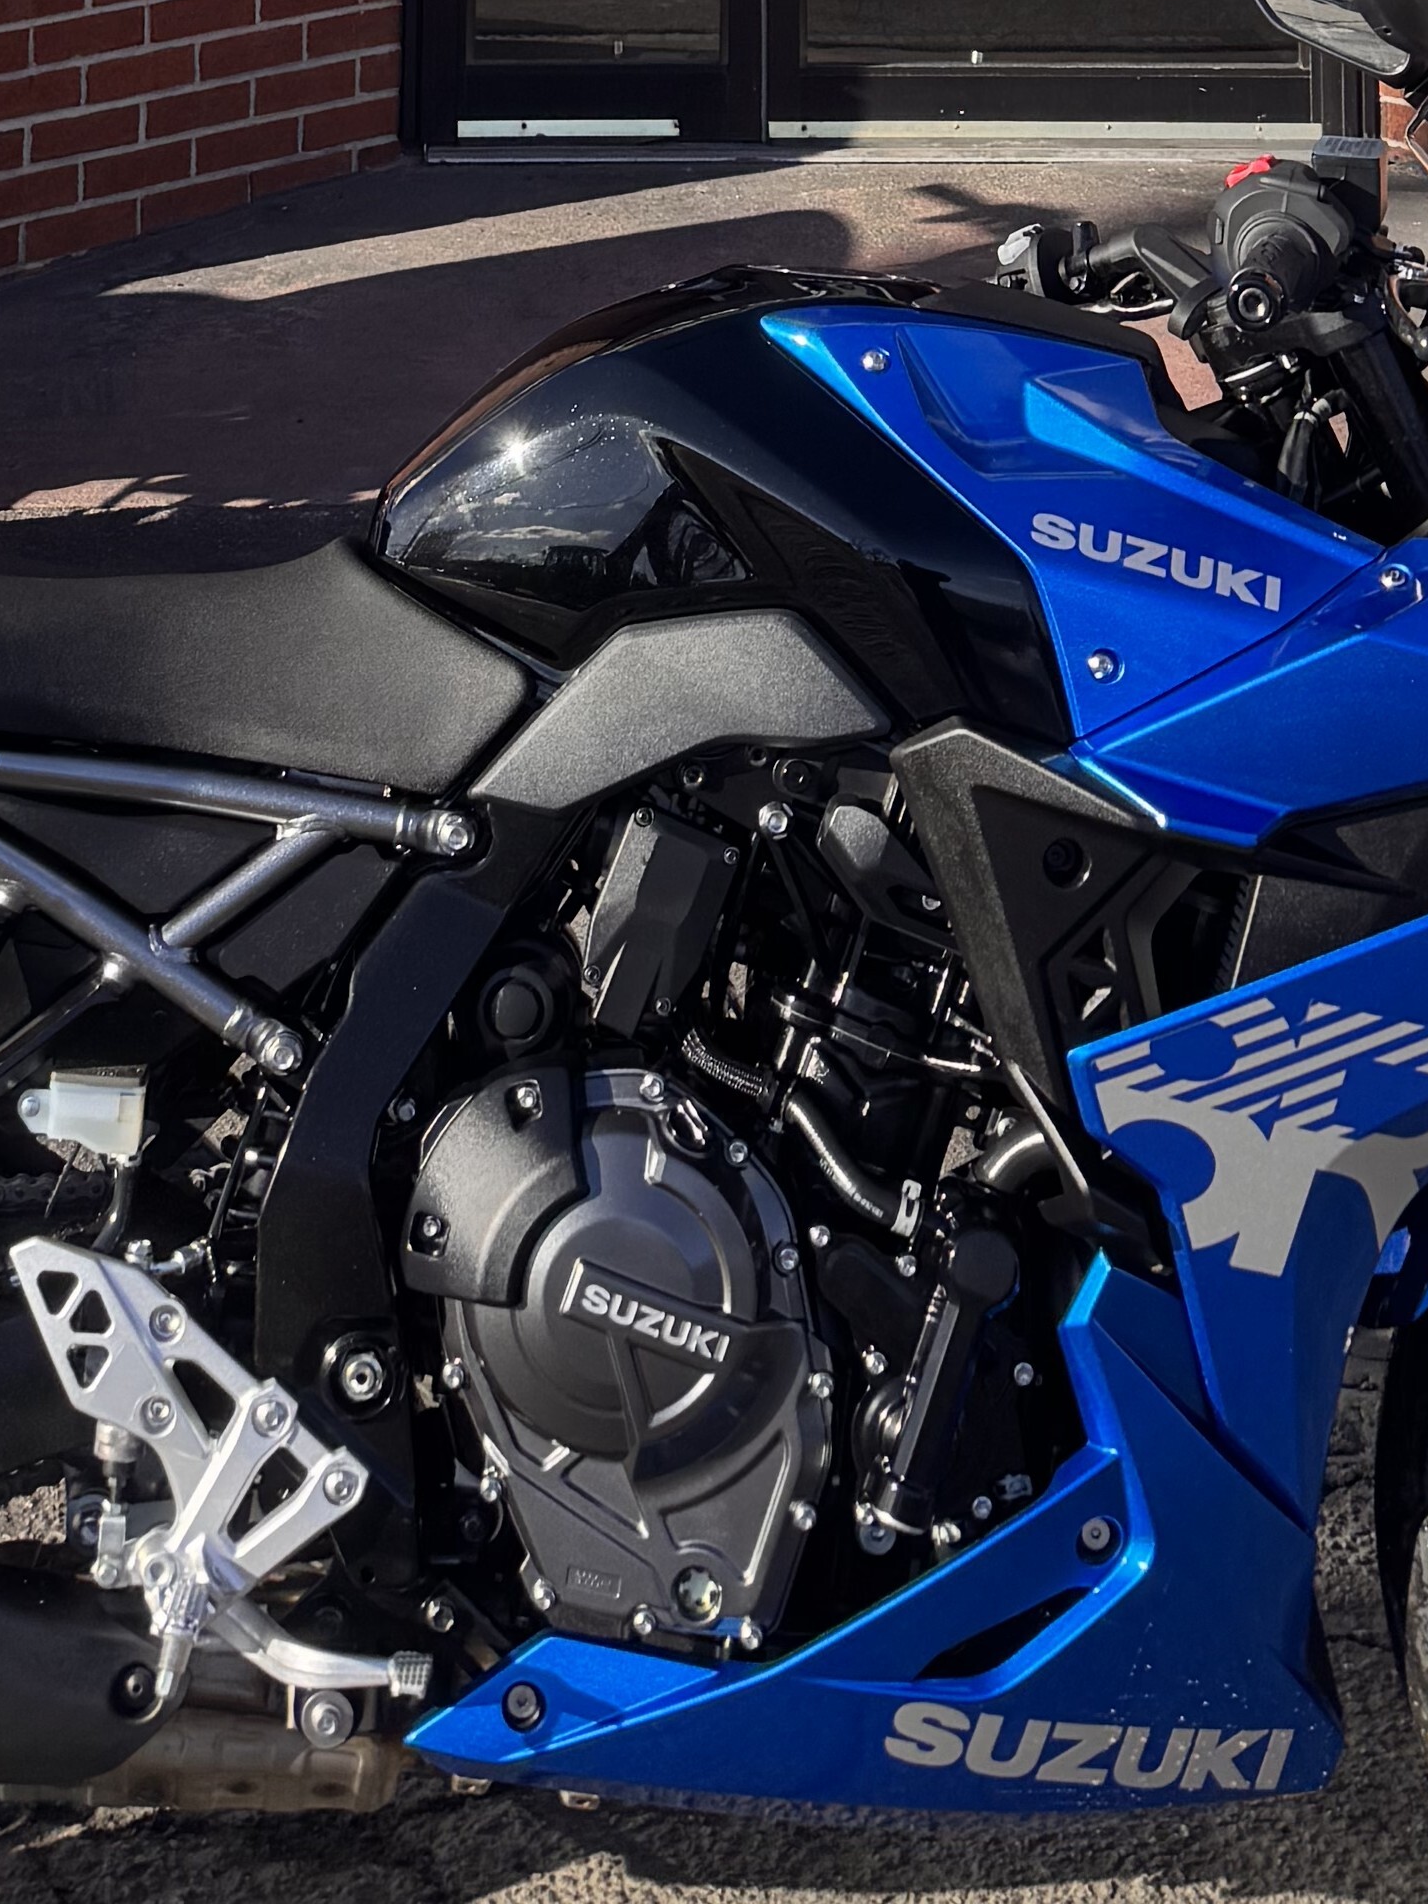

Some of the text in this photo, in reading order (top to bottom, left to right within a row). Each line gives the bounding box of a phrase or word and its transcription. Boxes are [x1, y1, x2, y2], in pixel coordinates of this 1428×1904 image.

[1029, 511, 1282, 612] SUZUKI
[580, 1283, 730, 1363] SUZUKI
[884, 1700, 1296, 1791] SUZUKI
